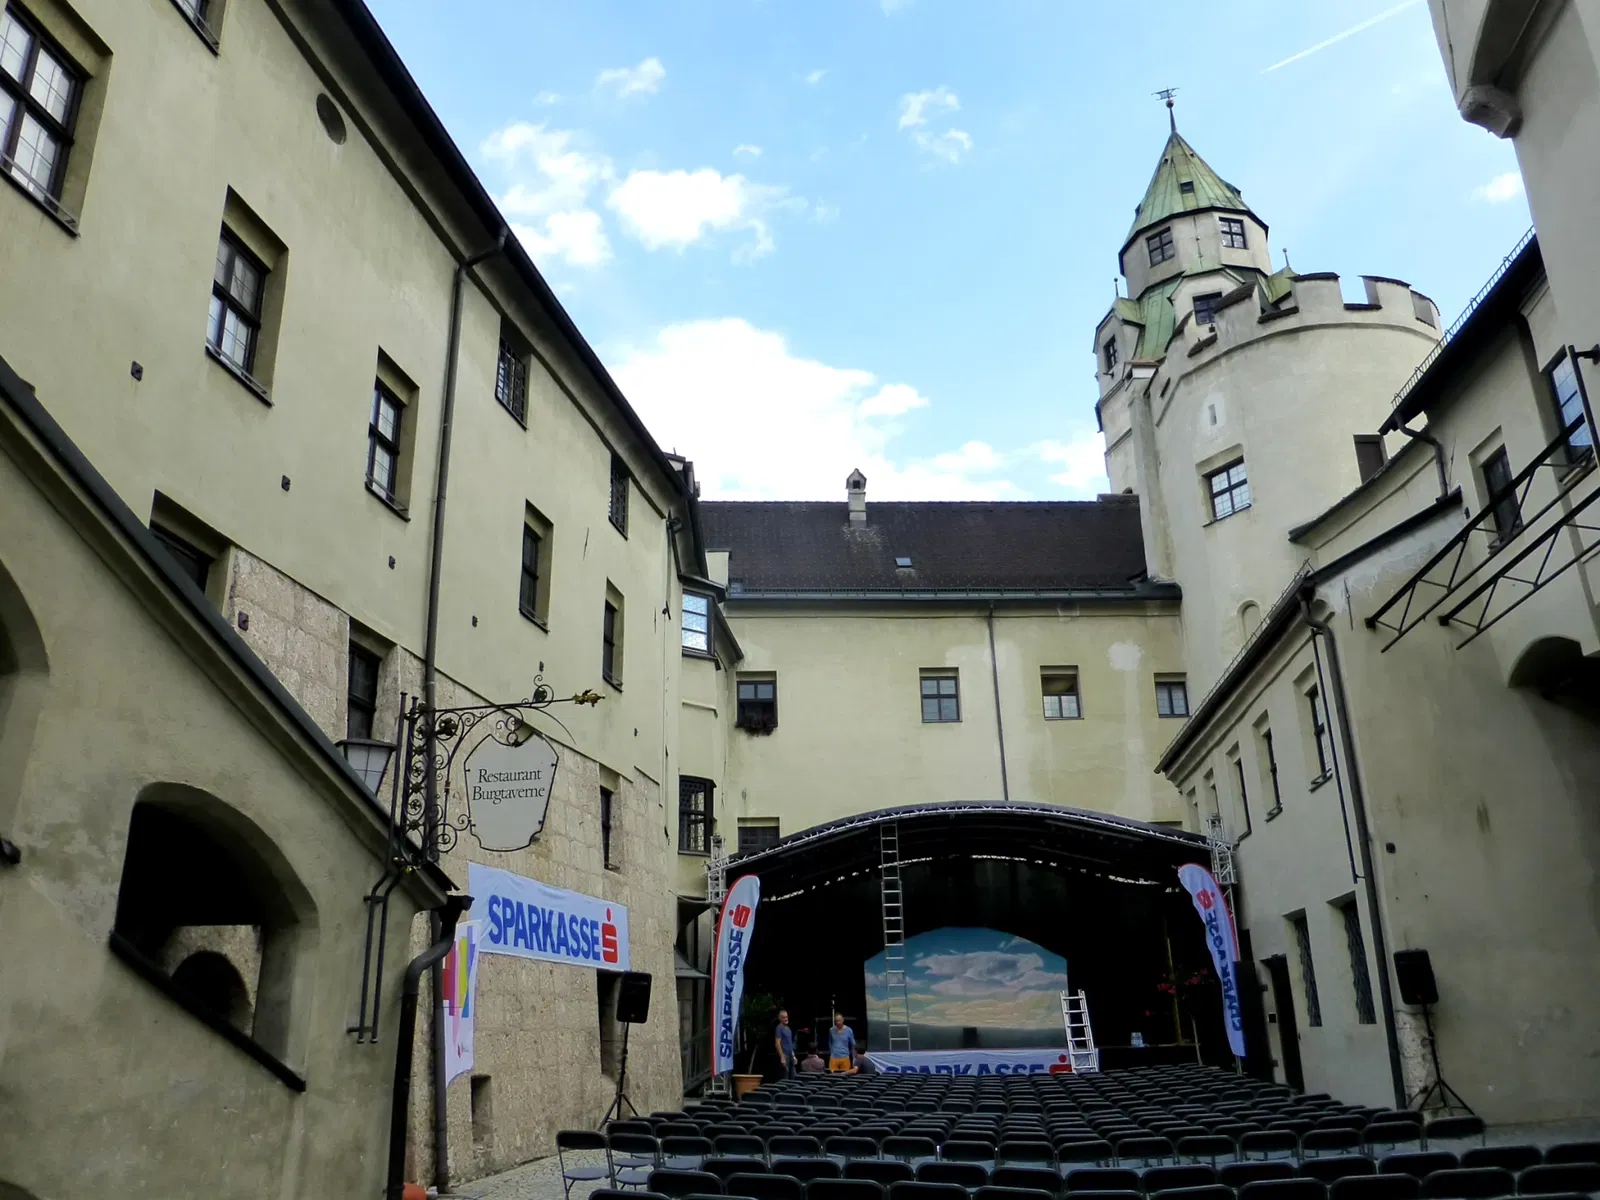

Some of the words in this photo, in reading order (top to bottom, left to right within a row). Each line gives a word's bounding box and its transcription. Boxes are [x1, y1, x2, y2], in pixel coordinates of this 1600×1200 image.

[472, 785, 545, 804] Burgtaverne
[478, 768, 542, 783] Restaurant
[488, 895, 601, 961] SPARKASSE
[720, 928, 743, 1058] SPARKASSE
